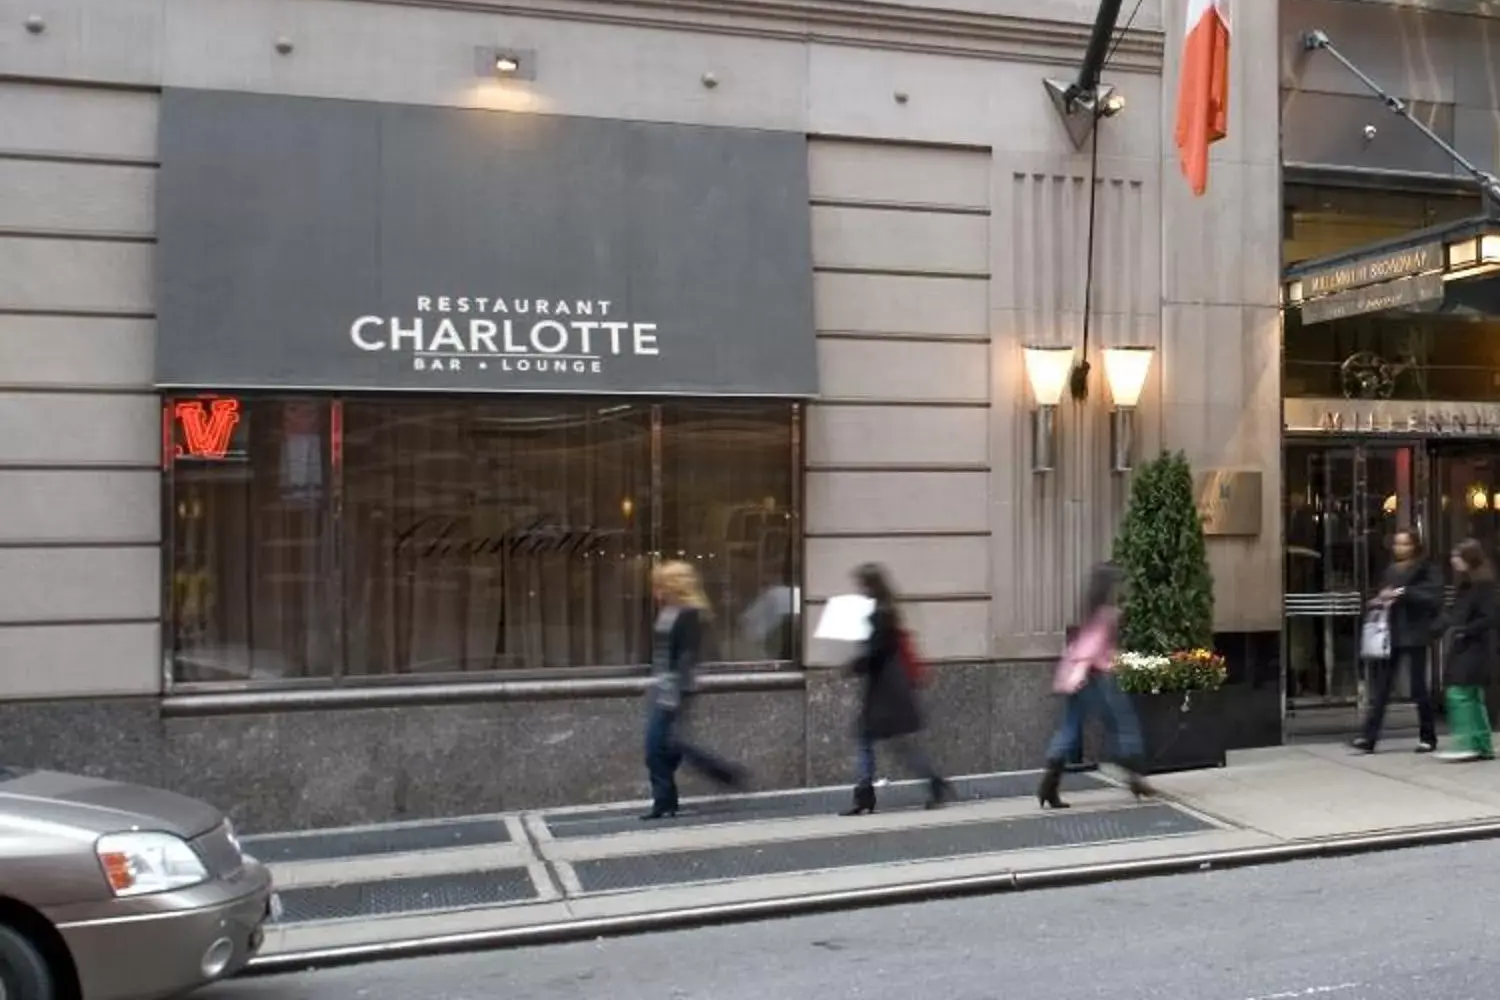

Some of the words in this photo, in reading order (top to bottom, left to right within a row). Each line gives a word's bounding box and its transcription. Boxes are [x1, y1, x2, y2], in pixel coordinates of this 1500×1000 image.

[416, 295, 612, 315] RESTAURANT
[350, 315, 659, 355] CHARLOTTE
[413, 357, 462, 371] BAR
[502, 359, 602, 373] LOUNGE
